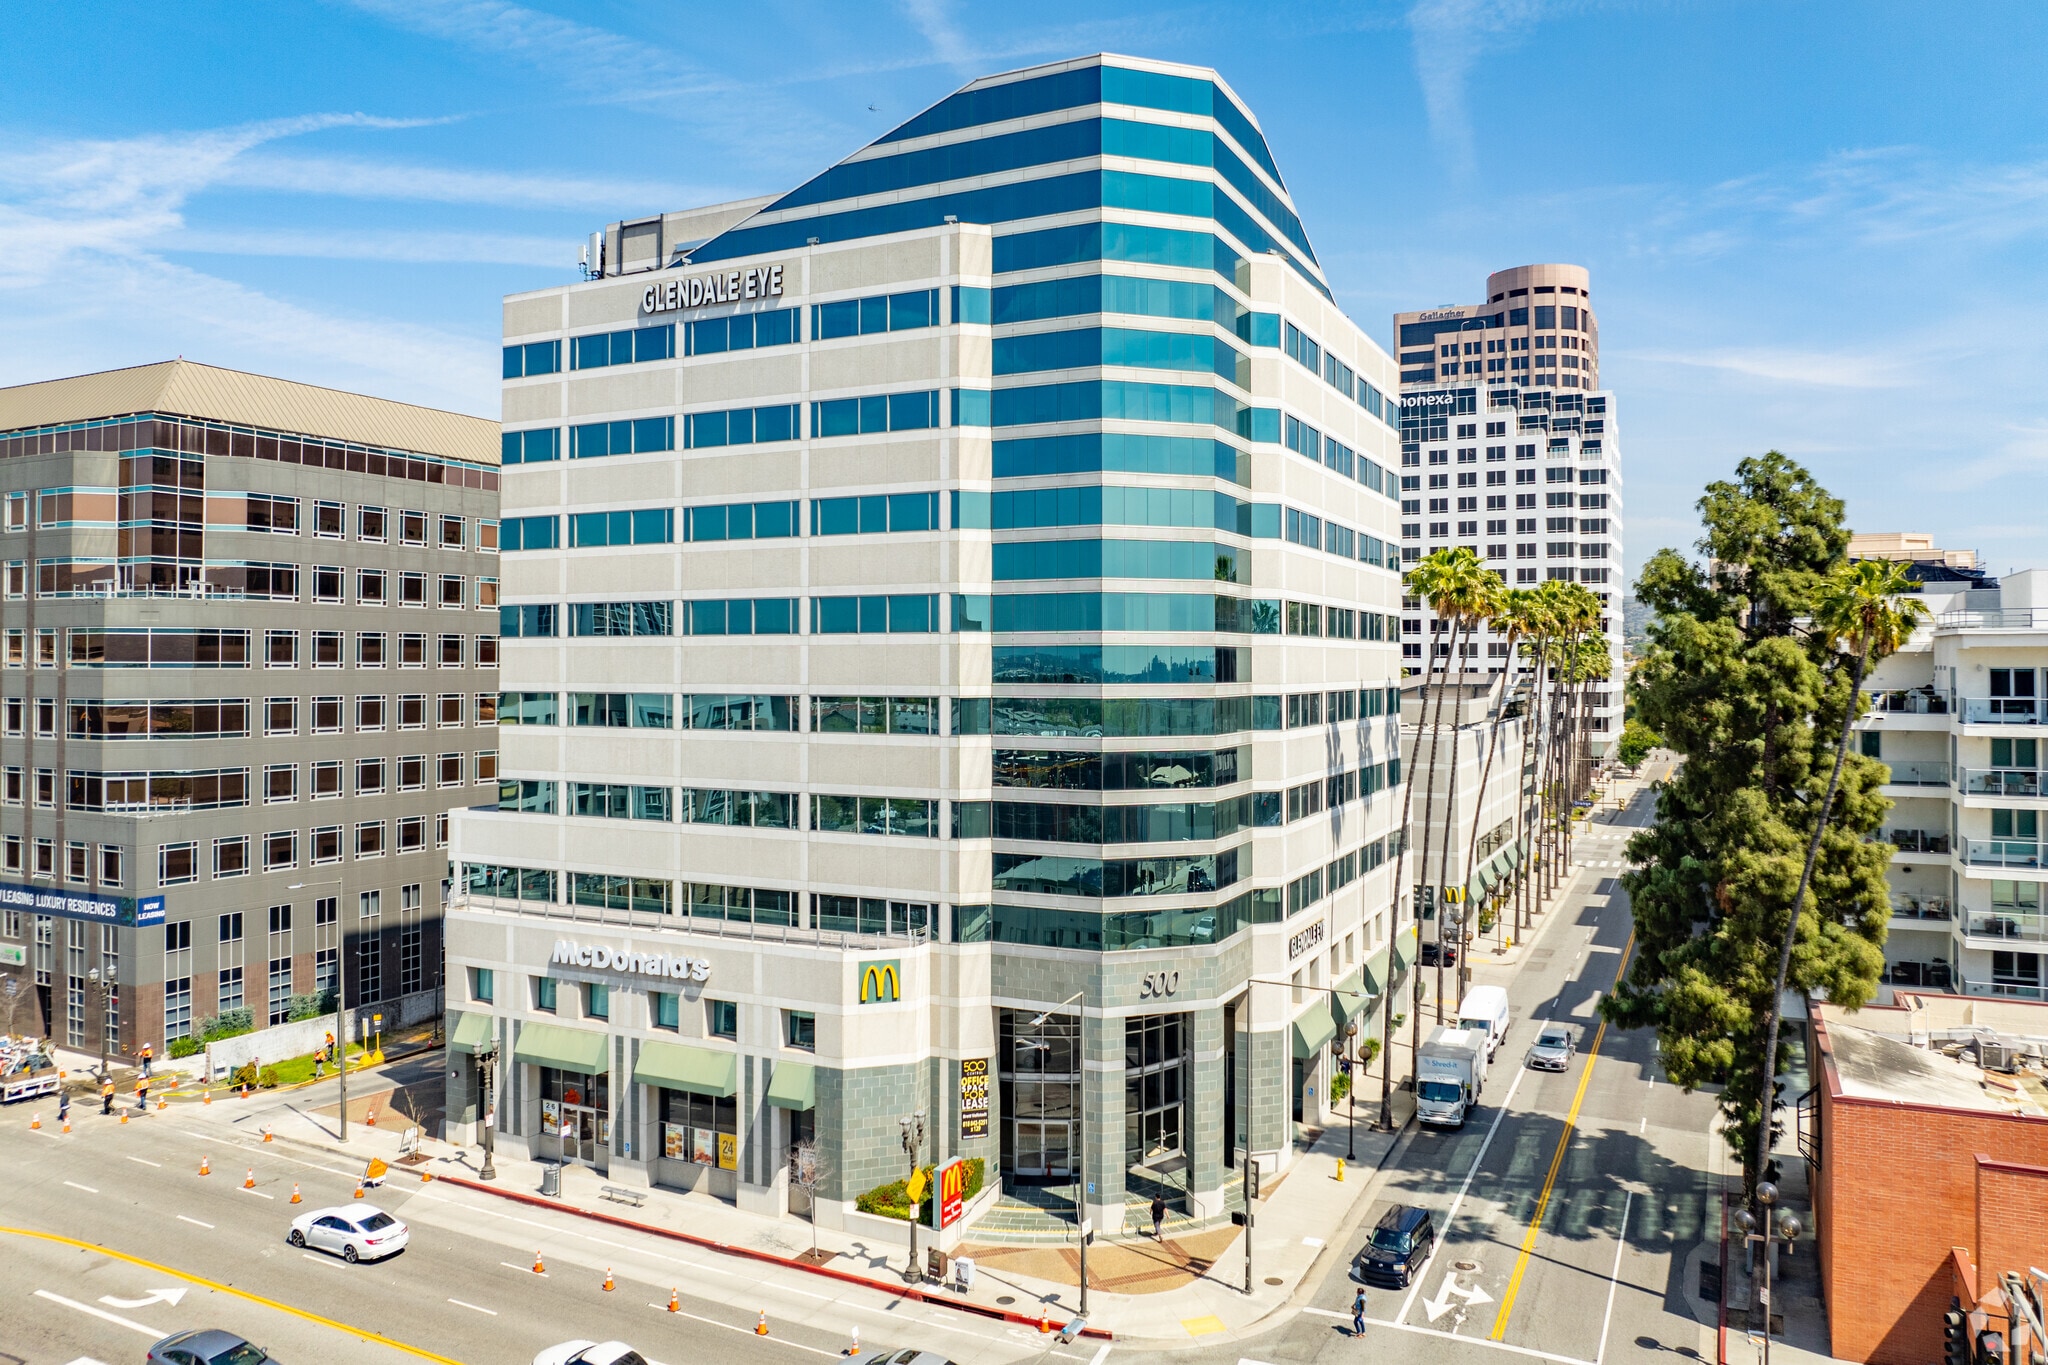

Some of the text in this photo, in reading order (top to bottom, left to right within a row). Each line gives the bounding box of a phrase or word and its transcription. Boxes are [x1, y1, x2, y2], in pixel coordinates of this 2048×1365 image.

[643, 264, 783, 314] GLENDALE EYE
[1420, 310, 1465, 320] Gallagher
[2, 889, 35, 906] LEASING
[36, 894, 67, 911] LUXURY
[67, 898, 116, 917] RESIDENCES
[143, 902, 160, 911] NOW
[138, 910, 165, 920] LEASING
[552, 940, 712, 982] McDonald's
[1141, 971, 1180, 999] 500
[963, 1060, 986, 1072] 500
[1432, 1060, 1458, 1069] Shred-it
[961, 1075, 989, 1086] OFFICE
[961, 1083, 989, 1093] SPACE
[964, 1090, 985, 1100] FOR
[962, 1097, 988, 1110] LEASE
[722, 1140, 734, 1155] 24
